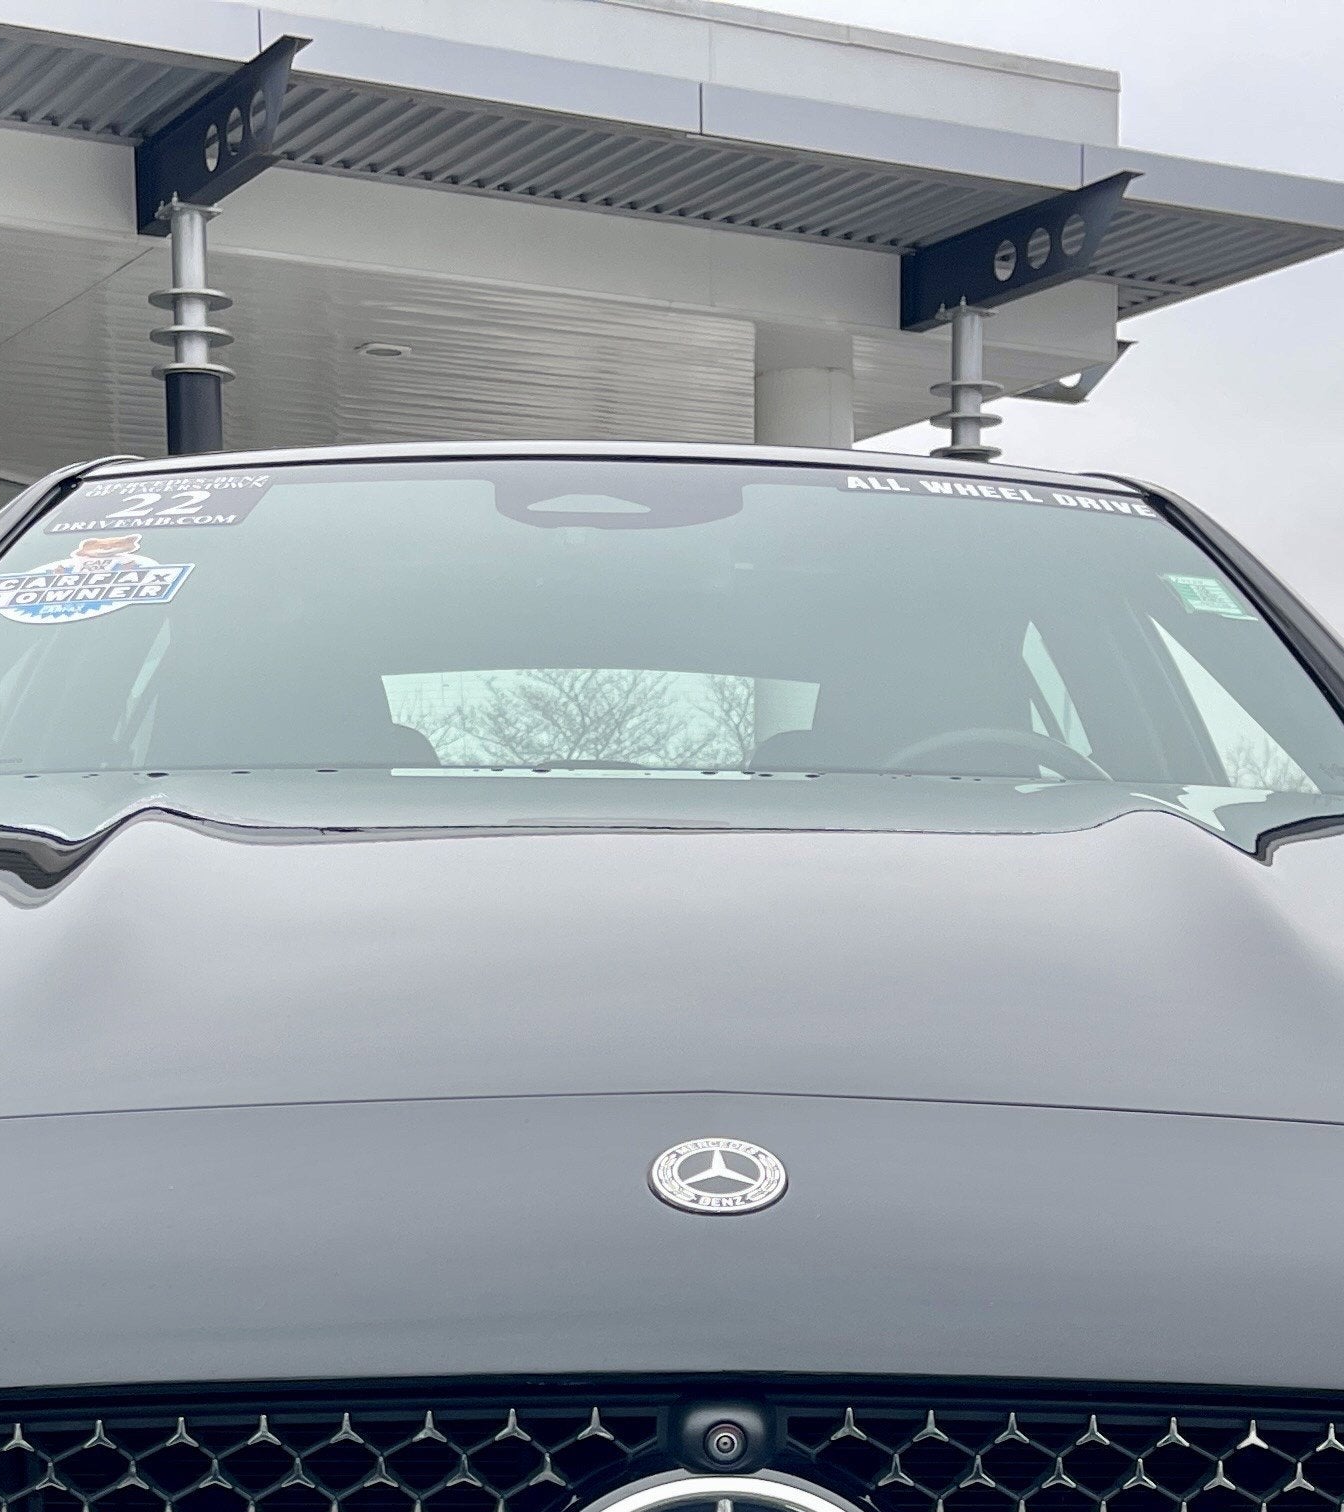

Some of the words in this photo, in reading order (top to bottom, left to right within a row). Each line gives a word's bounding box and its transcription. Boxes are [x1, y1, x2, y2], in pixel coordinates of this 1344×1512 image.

[106, 490, 212, 518] 22
[846, 476, 910, 491] ALL
[920, 480, 1044, 503] WHEEL
[1052, 493, 1157, 518] DRIVE
[51, 514, 238, 533] DRIVEMB.COM
[15, 585, 164, 605] OWNER
